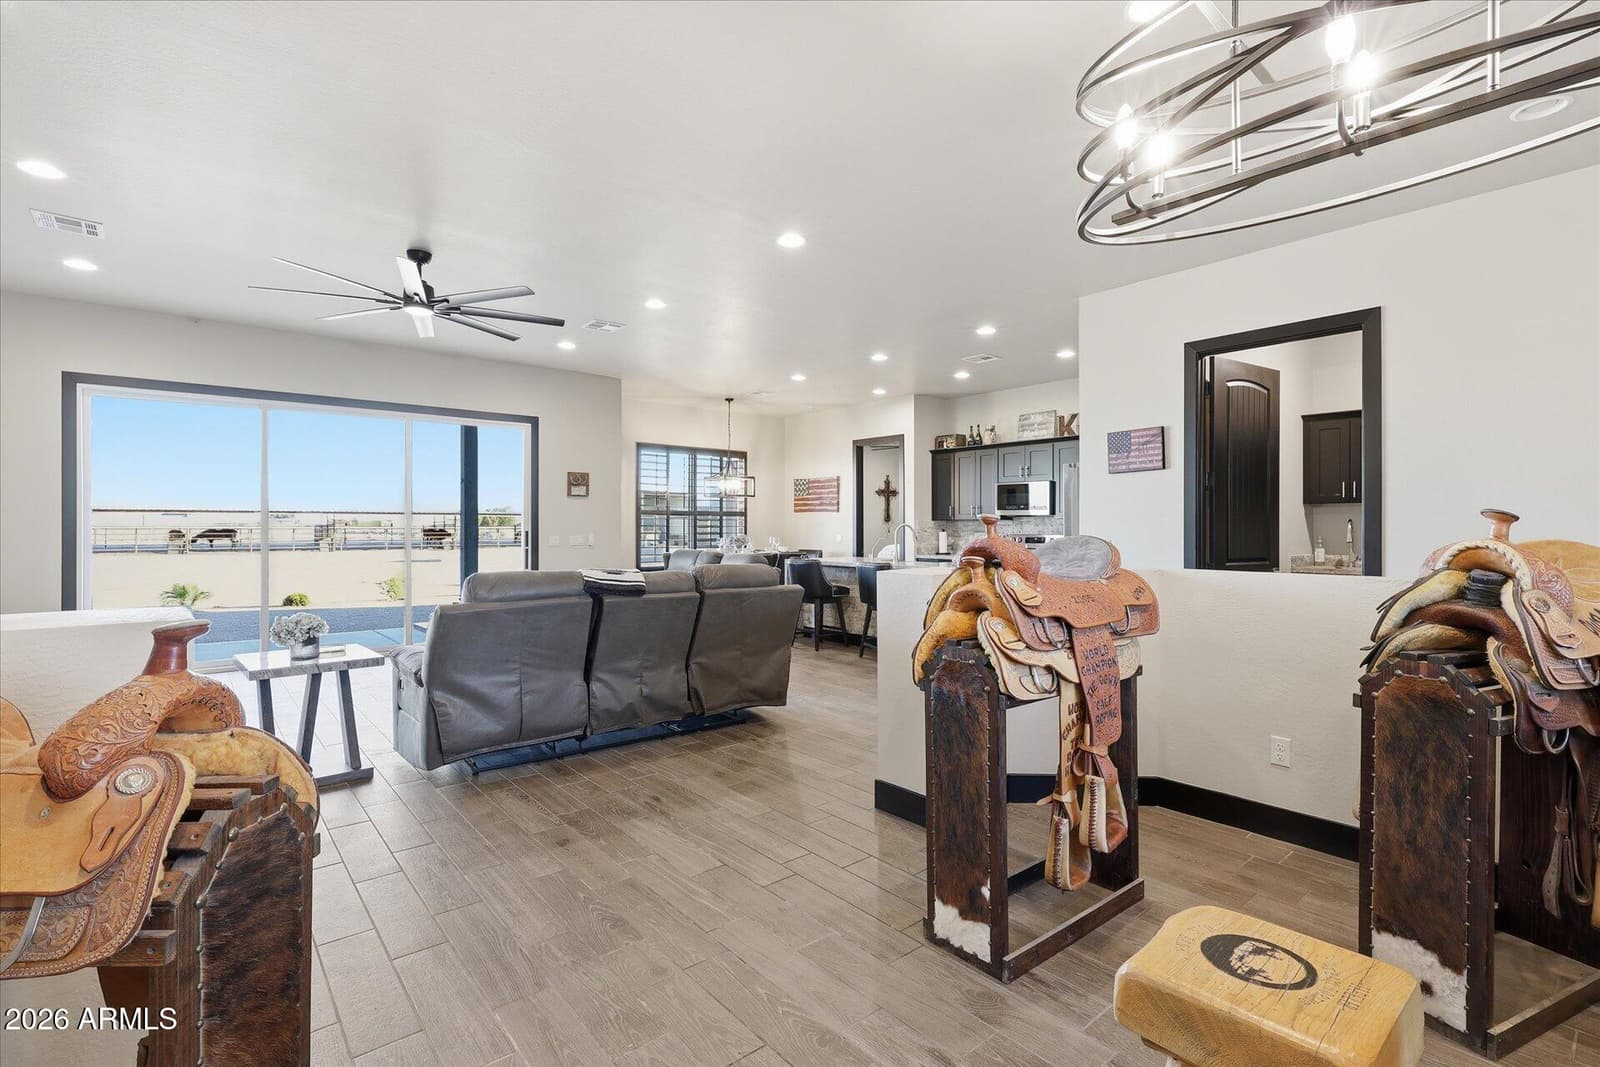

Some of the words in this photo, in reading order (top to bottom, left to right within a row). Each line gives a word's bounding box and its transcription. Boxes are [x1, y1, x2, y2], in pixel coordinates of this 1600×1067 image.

[1057, 412, 1079, 437] K
[1083, 644, 1109, 661] WORLD
[1080, 656, 1118, 677] CHAMPION
[1087, 681, 1098, 697] TIE
